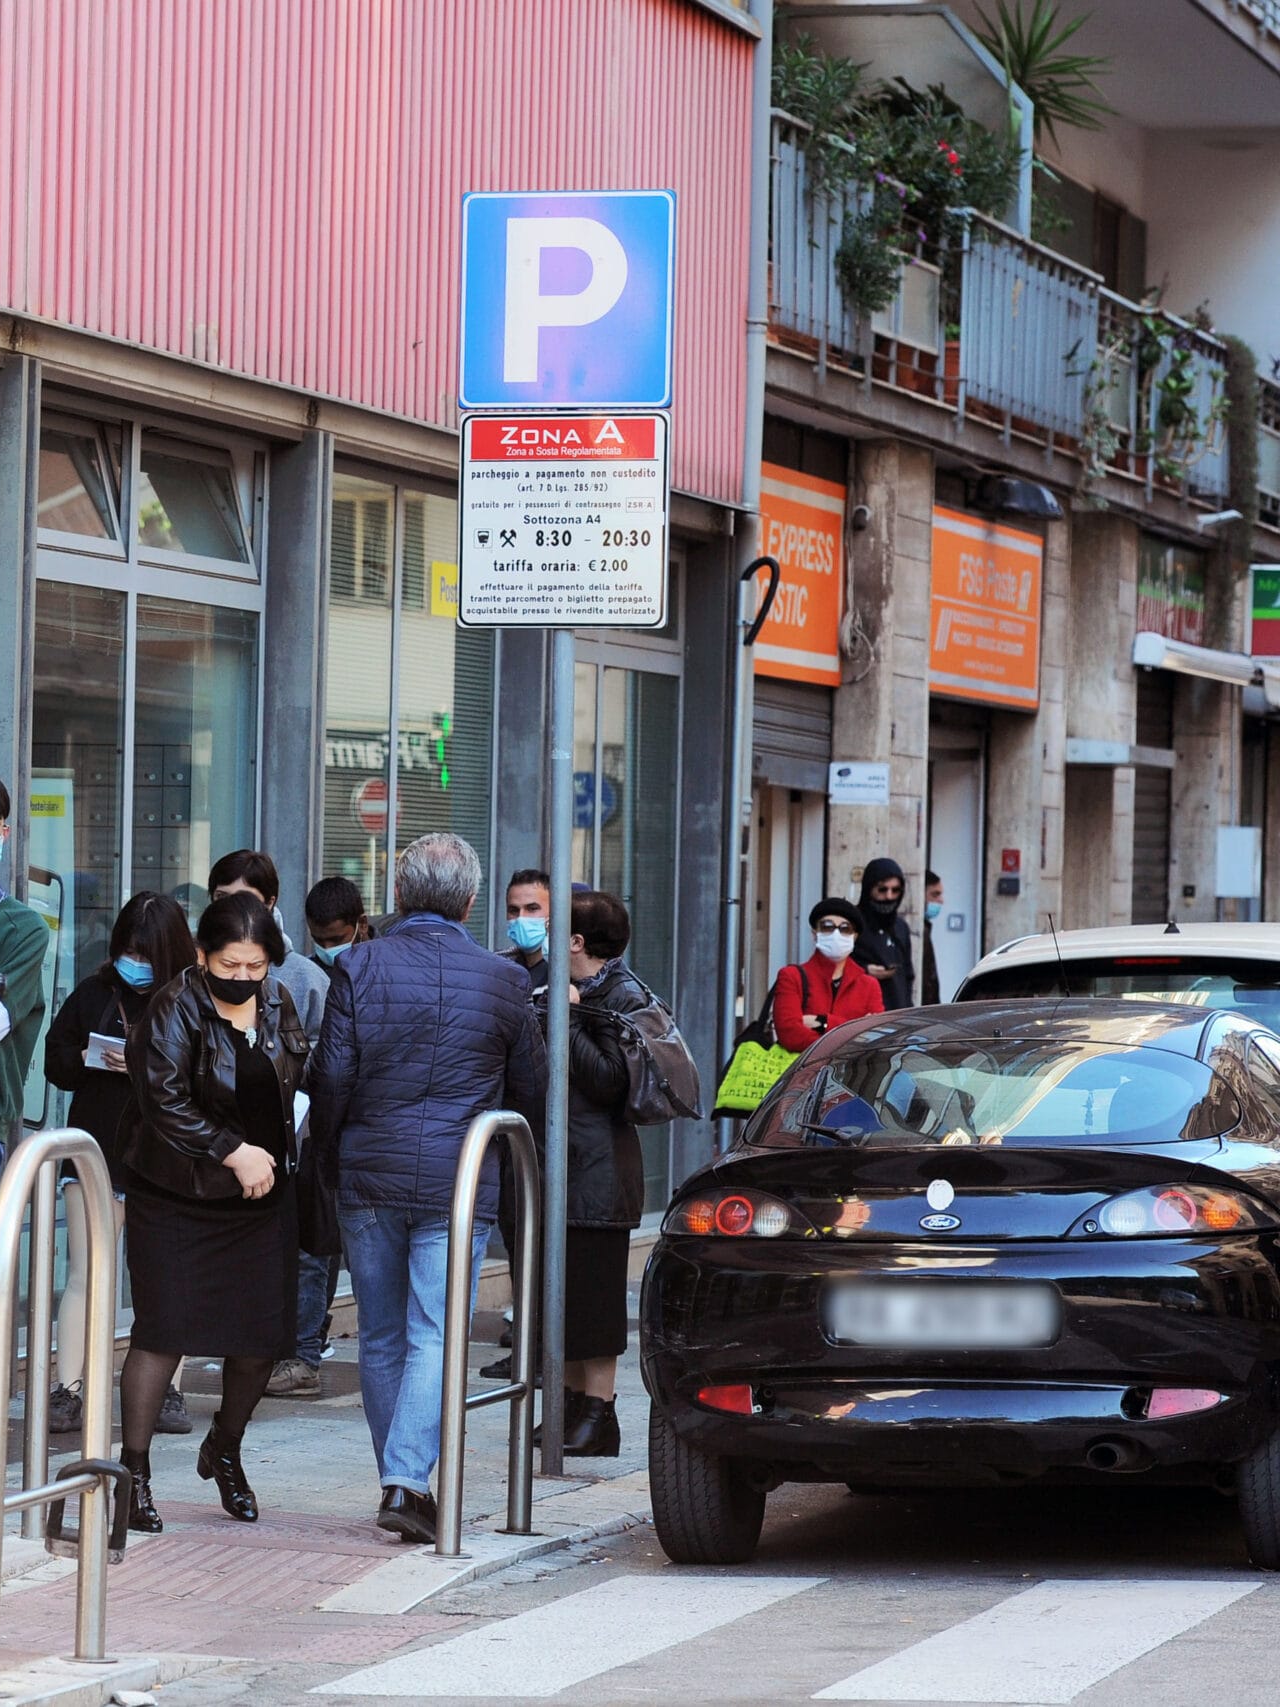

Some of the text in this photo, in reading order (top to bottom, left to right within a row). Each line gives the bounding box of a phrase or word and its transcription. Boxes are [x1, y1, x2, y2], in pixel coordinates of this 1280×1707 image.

[503, 217, 629, 383] P
[500, 420, 625, 445] ZONA A
[506, 446, 527, 457] Zona
[536, 446, 559, 457] Sosta
[561, 446, 622, 457] Regolamentata
[471, 470, 520, 481] parcheggio
[536, 470, 585, 480] pagamento
[591, 470, 607, 478] non
[612, 468, 657, 478] custodito
[471, 501, 500, 510] gratuito
[503, 502, 515, 510] per
[525, 501, 561, 510] possessori
[564, 500, 571, 508] di
[575, 501, 622, 510] contrassegno
[523, 514, 602, 525] Sottozona A4
[535, 529, 573, 547] 8:30
[602, 529, 651, 547] 20:30
[768, 520, 835, 575] EXPRESS
[493, 559, 534, 572] tariffa
[541, 560, 581, 572] oraria:
[588, 559, 597, 572] €
[480, 583, 642, 593] effettuare il pagamento della tariffa
[470, 595, 501, 603] tramite
[505, 595, 554, 604] parcometro
[567, 594, 604, 604] biglietto
[608, 595, 653, 604] prepagato
[466, 606, 657, 615] acquistabile presso le rivendite autorizzate
